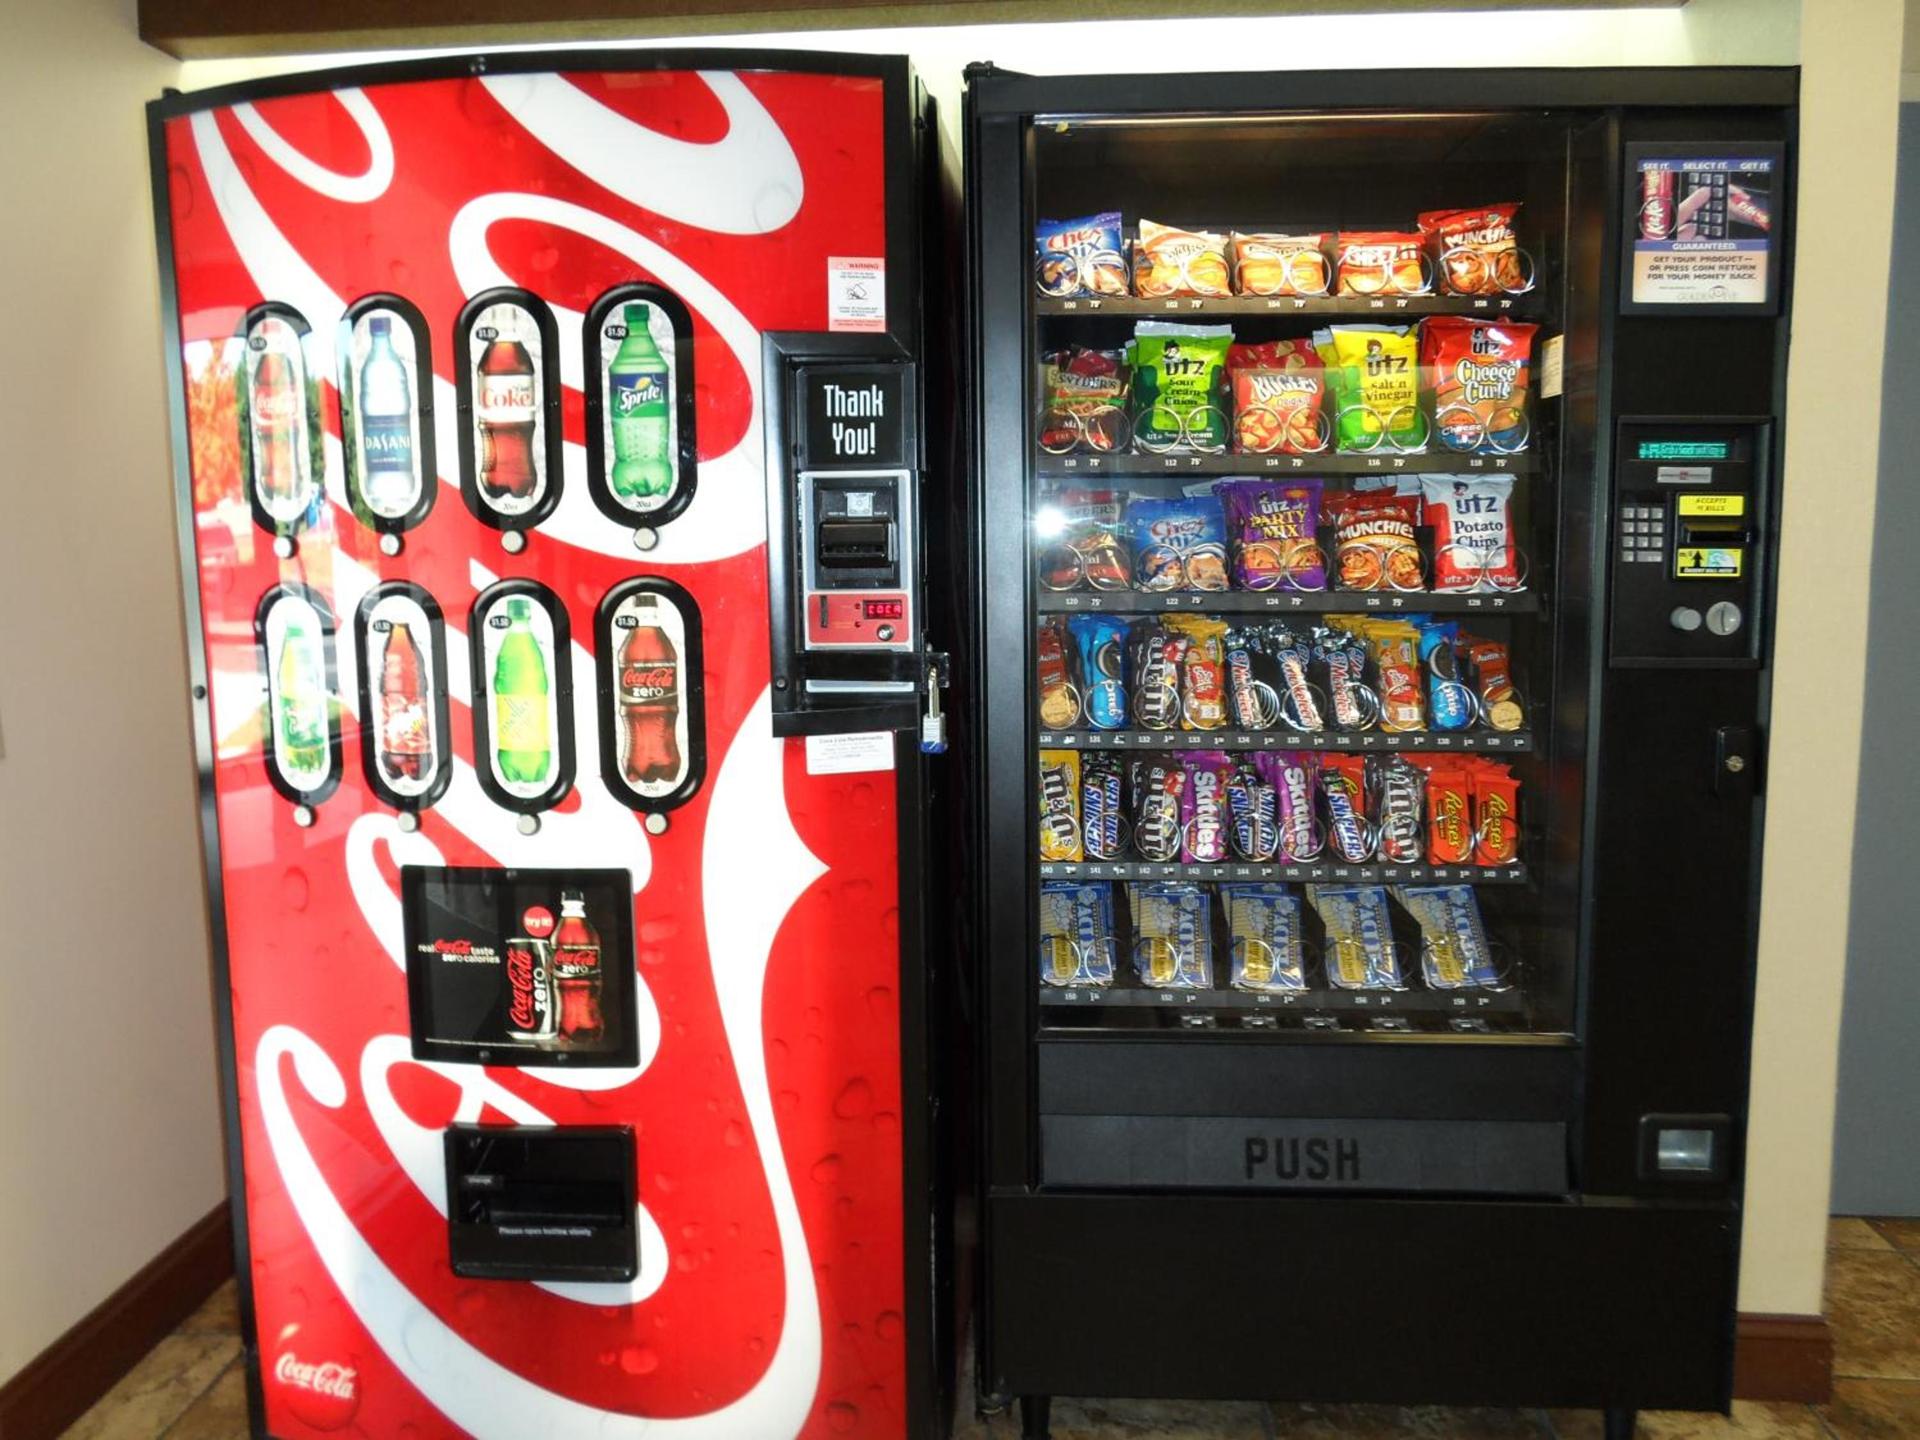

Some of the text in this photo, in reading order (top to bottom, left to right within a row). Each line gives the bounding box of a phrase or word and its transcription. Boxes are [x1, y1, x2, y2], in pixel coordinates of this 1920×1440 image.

[1445, 226, 1515, 247] MUNCHIE
[1456, 360, 1516, 385] Cheese
[620, 384, 661, 411] Sprite
[823, 384, 884, 417] Thank
[832, 422, 876, 455] You!
[1454, 520, 1503, 534] Potato
[1457, 536, 1499, 550] Chips
[1194, 771, 1220, 857] Skittles
[1228, 787, 1251, 855] SNIKERS
[1284, 768, 1311, 857] Skittles
[533, 967, 548, 1012] zero
[1245, 1136, 1360, 1181] PUSH
